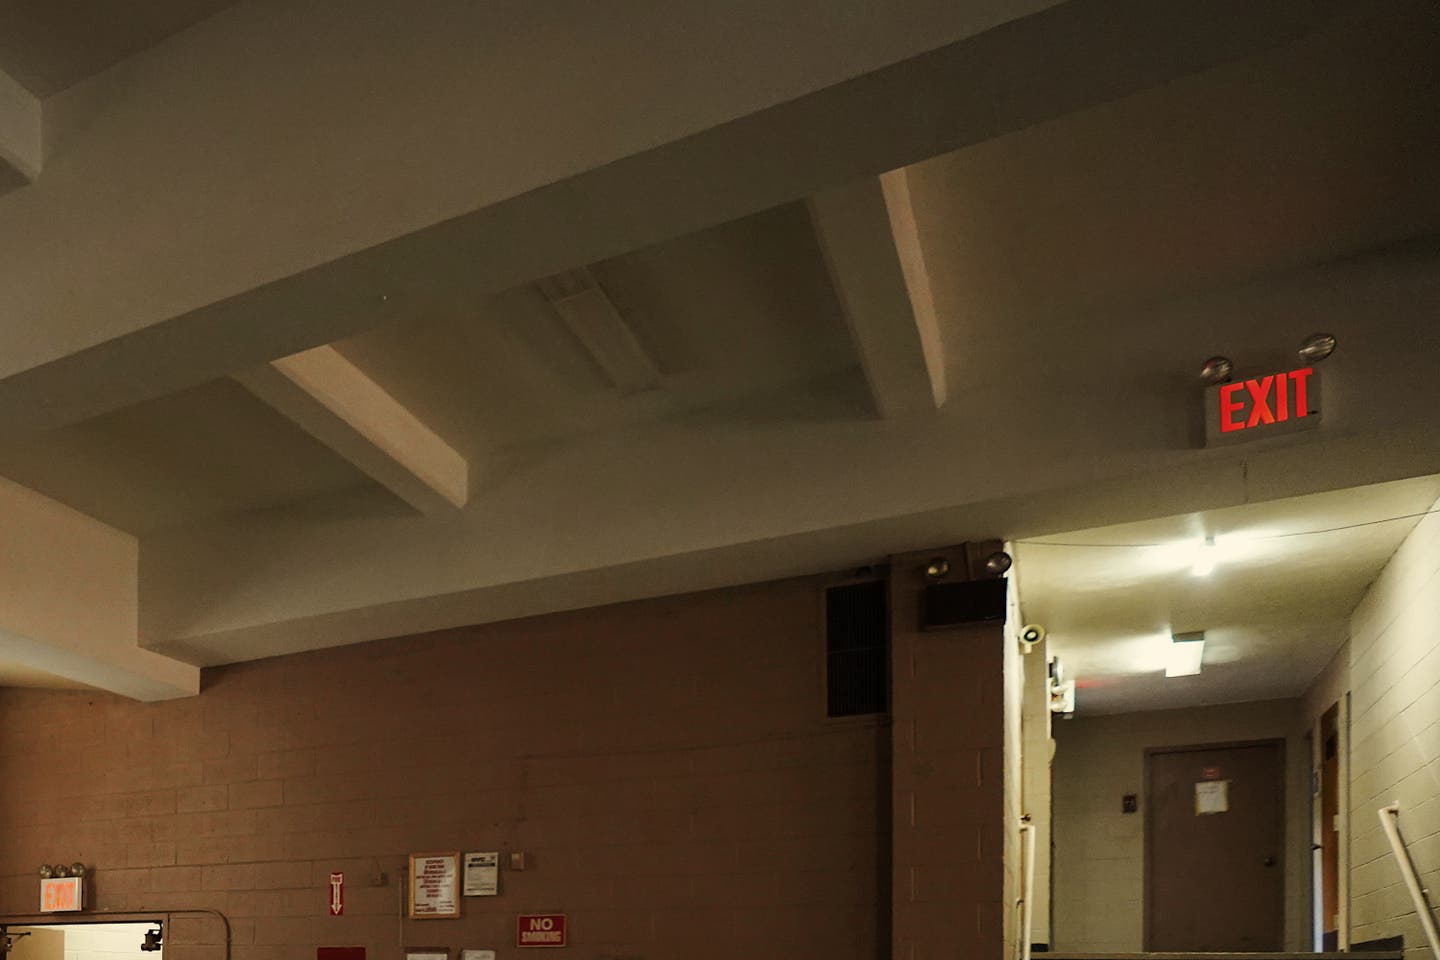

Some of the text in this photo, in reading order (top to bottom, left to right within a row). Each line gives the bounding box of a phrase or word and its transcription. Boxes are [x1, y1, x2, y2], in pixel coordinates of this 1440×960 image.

[1219, 368, 1313, 433] EXIT
[45, 882, 75, 910] EXIT
[530, 918, 554, 931] NO
